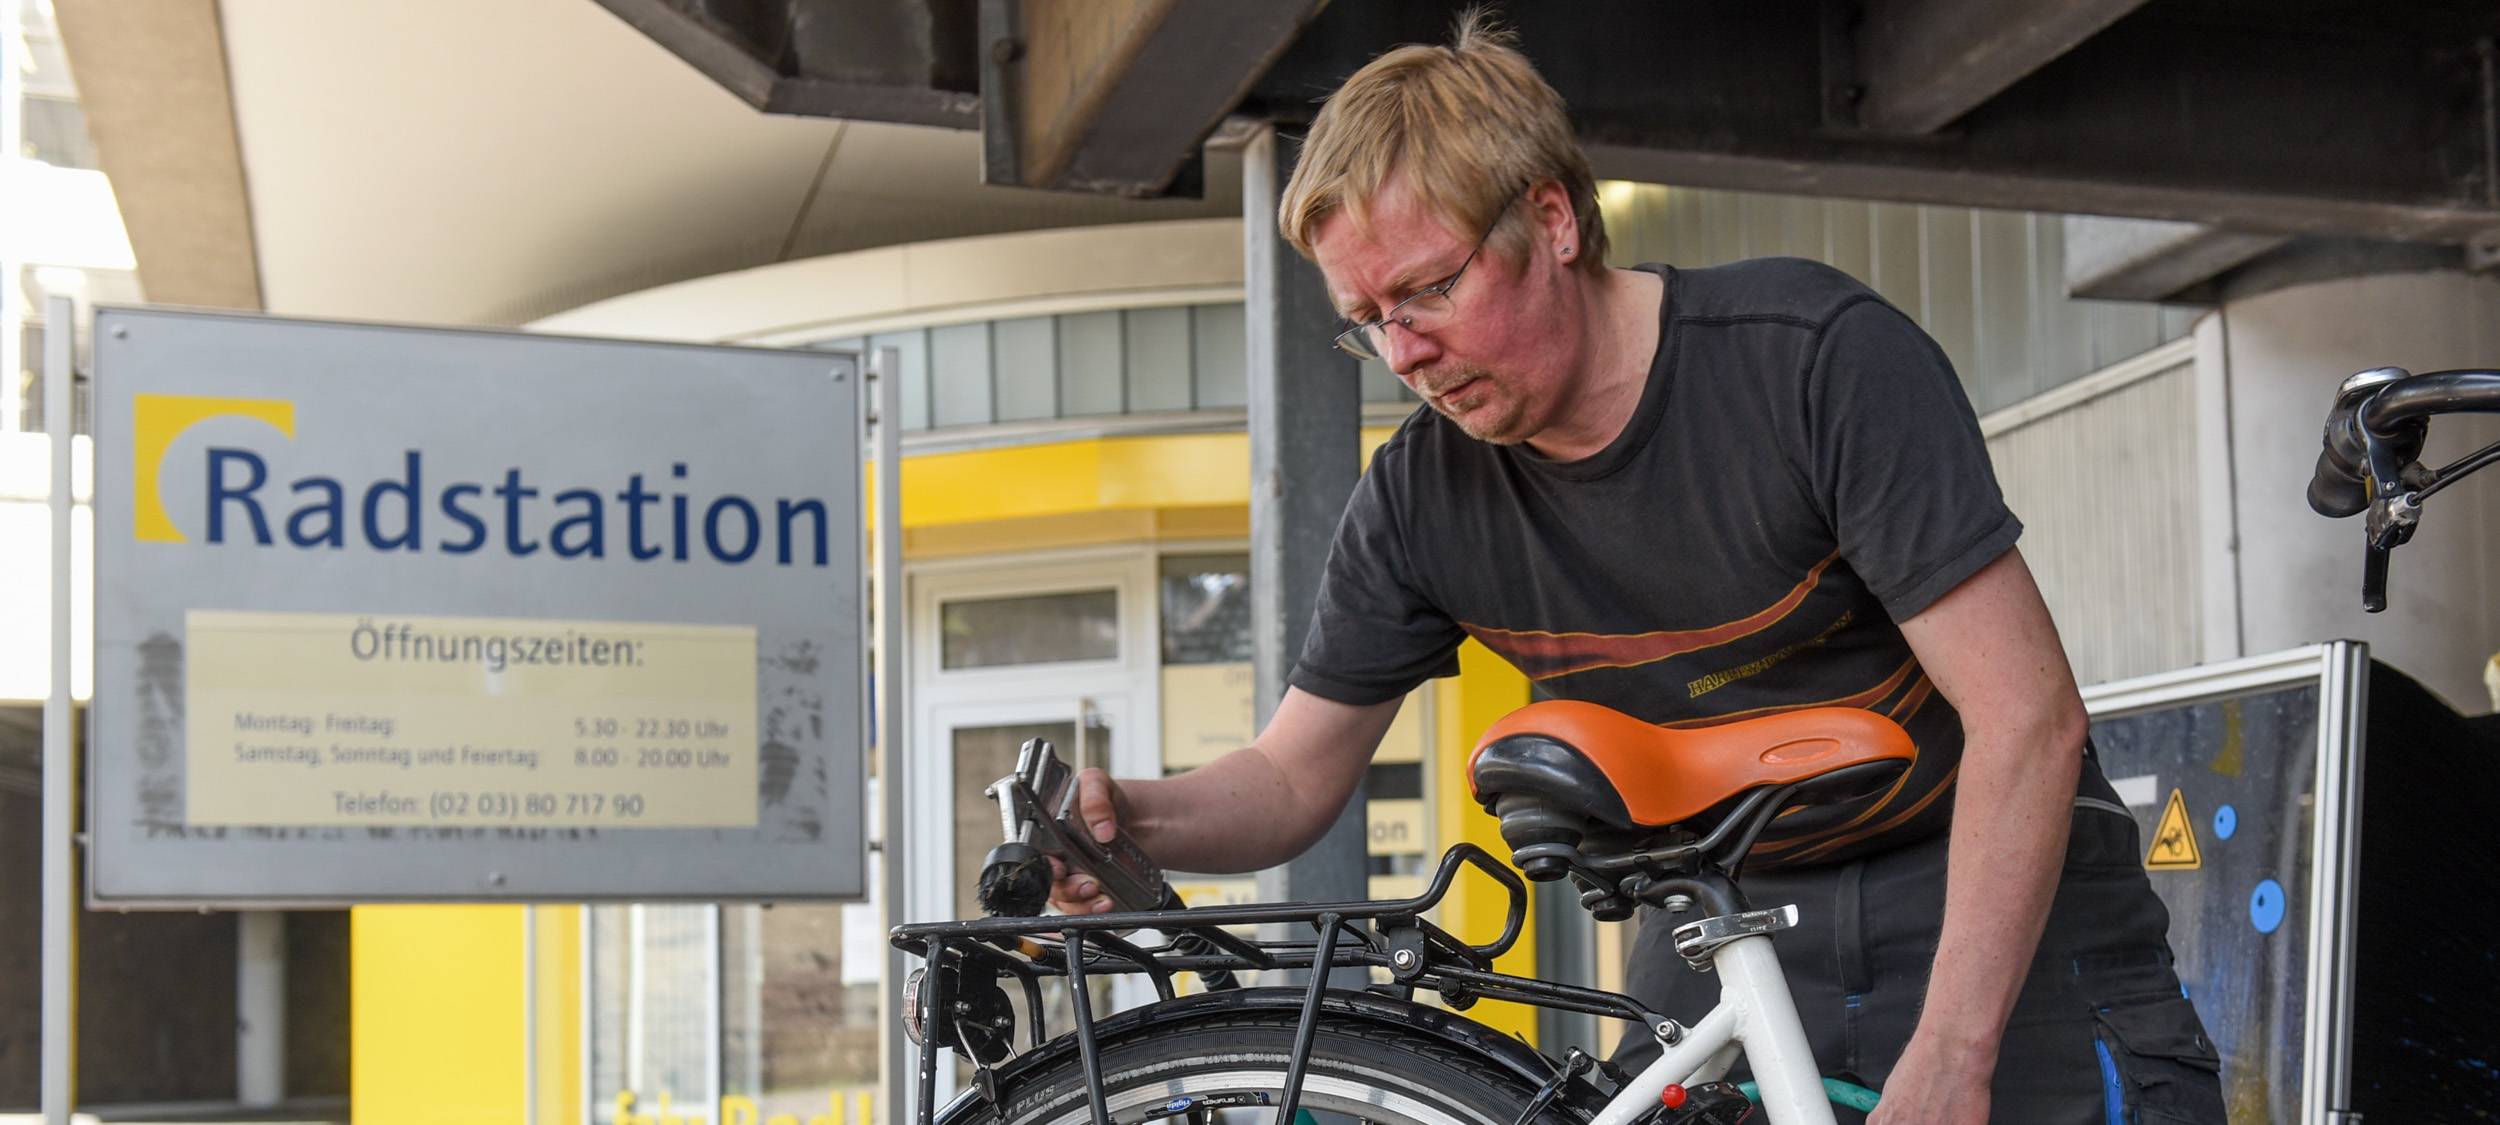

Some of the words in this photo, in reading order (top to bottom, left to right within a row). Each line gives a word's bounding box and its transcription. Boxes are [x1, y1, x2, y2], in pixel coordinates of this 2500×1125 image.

[206, 447, 829, 567] Radstation
[350, 618, 645, 672] Öffnungszeiten:
[574, 718, 618, 738] 5.30
[635, 718, 690, 739] 22.30
[695, 718, 730, 739] Uhr
[330, 744, 411, 769] Sonntag
[418, 747, 456, 766] und
[574, 747, 619, 768] 8.00
[637, 748, 691, 769] 20.00
[696, 748, 731, 770] Uhr
[333, 791, 420, 816] Telefon:
[429, 791, 470, 818] (02
[477, 791, 518, 818] 03)
[525, 793, 557, 817] 80
[566, 793, 606, 817] 717
[612, 793, 645, 818] 90
